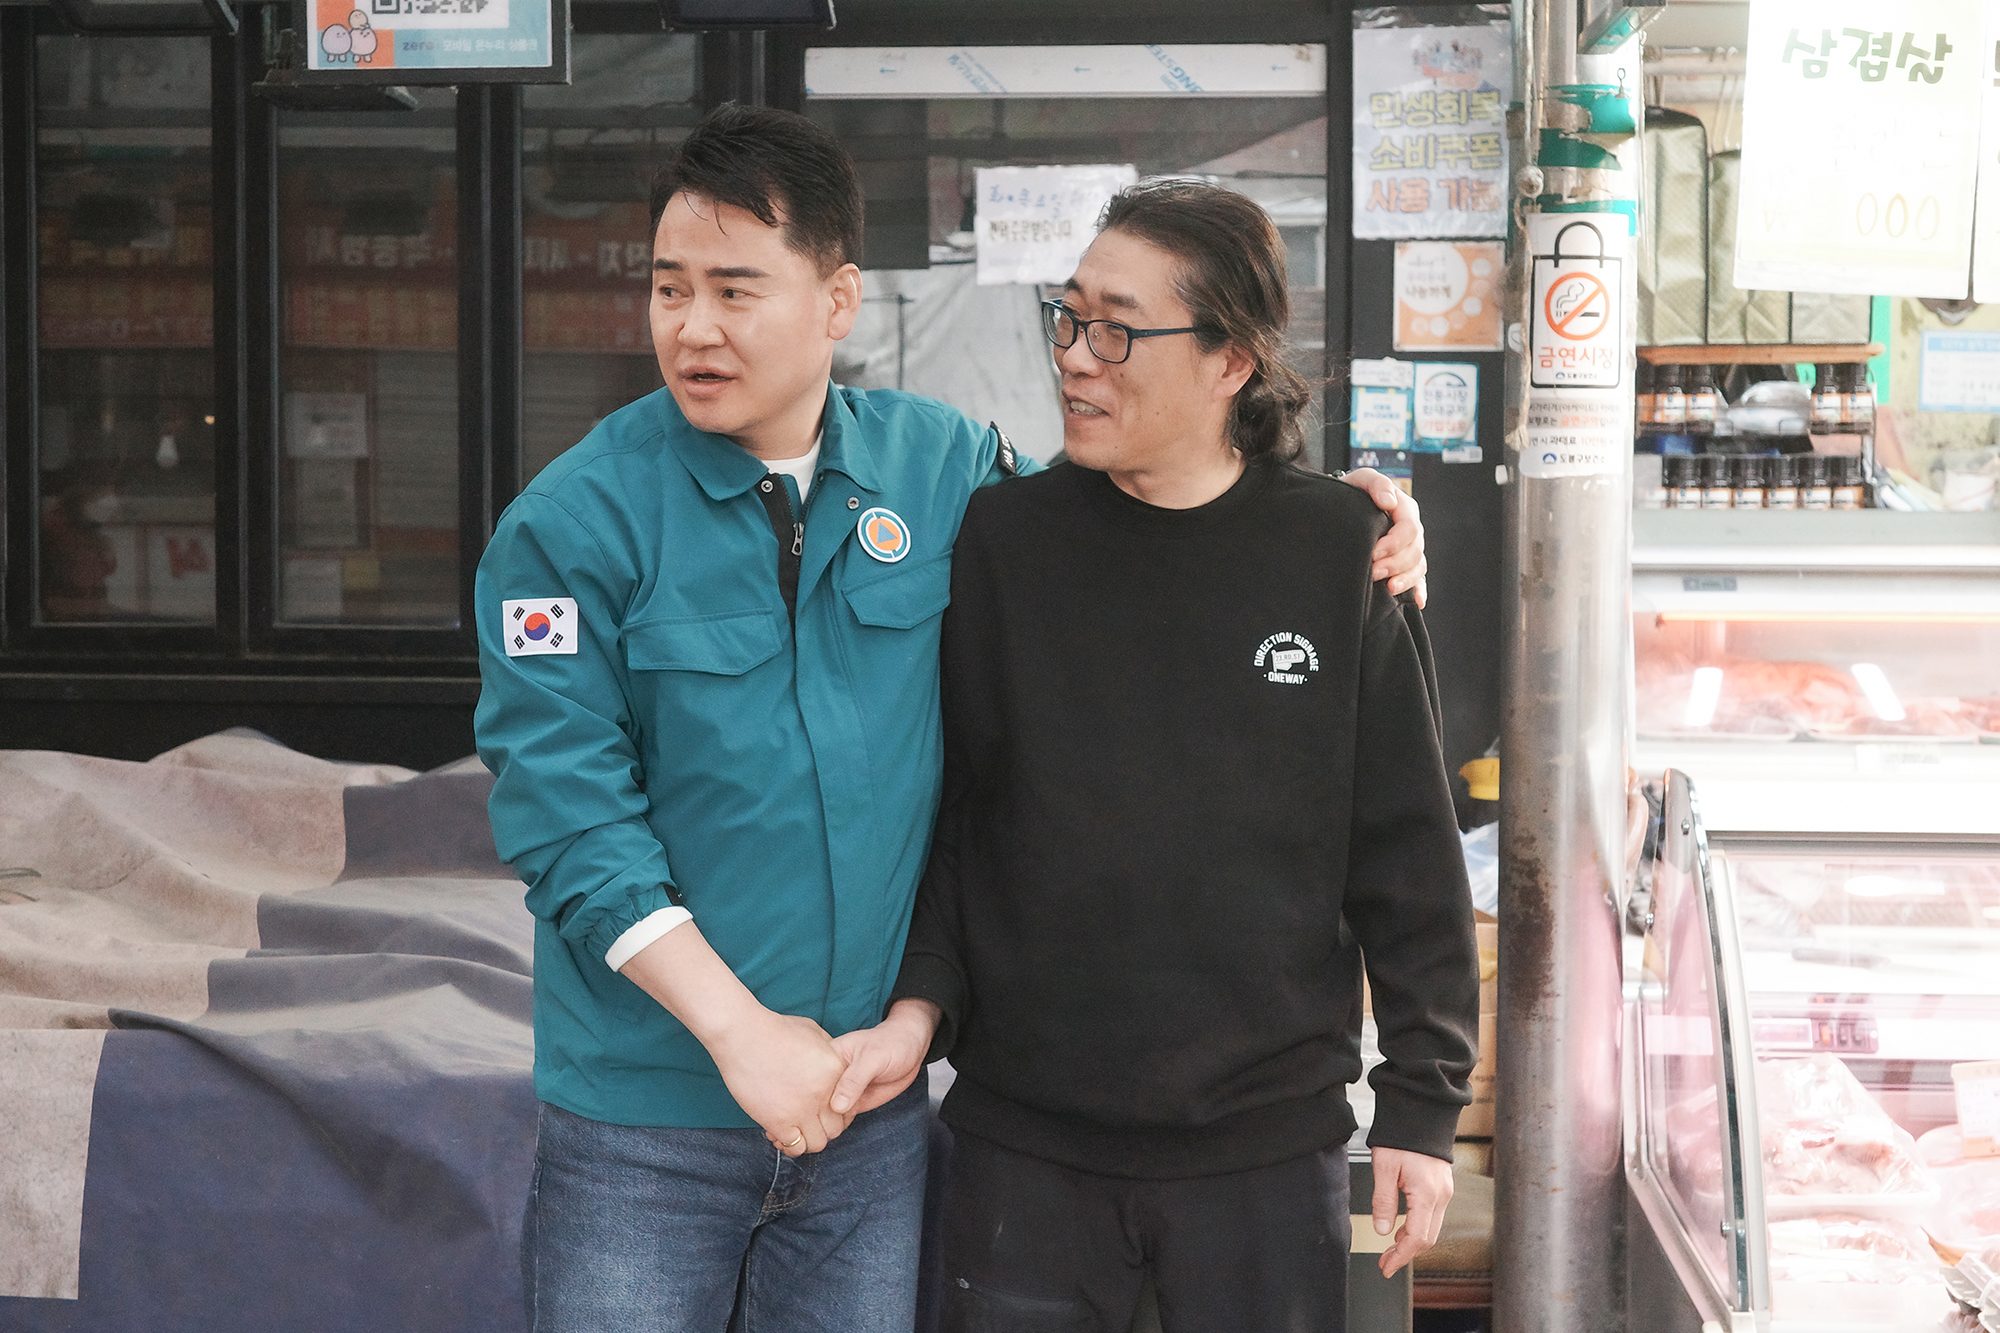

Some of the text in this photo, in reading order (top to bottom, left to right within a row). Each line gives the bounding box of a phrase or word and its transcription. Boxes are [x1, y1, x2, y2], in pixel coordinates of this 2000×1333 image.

[1782, 27, 1953, 84] 삼겹살
[1370, 91, 1502, 128] 민생회복
[1369, 132, 1503, 170] 소비쿠폰
[1367, 177, 1502, 213] 사용 가능
[1538, 346, 1613, 369] 금연시장
[1254, 632, 1319, 672] DIRECTION SIGNAGE
[1268, 671, 1305, 685] ONEWAY
